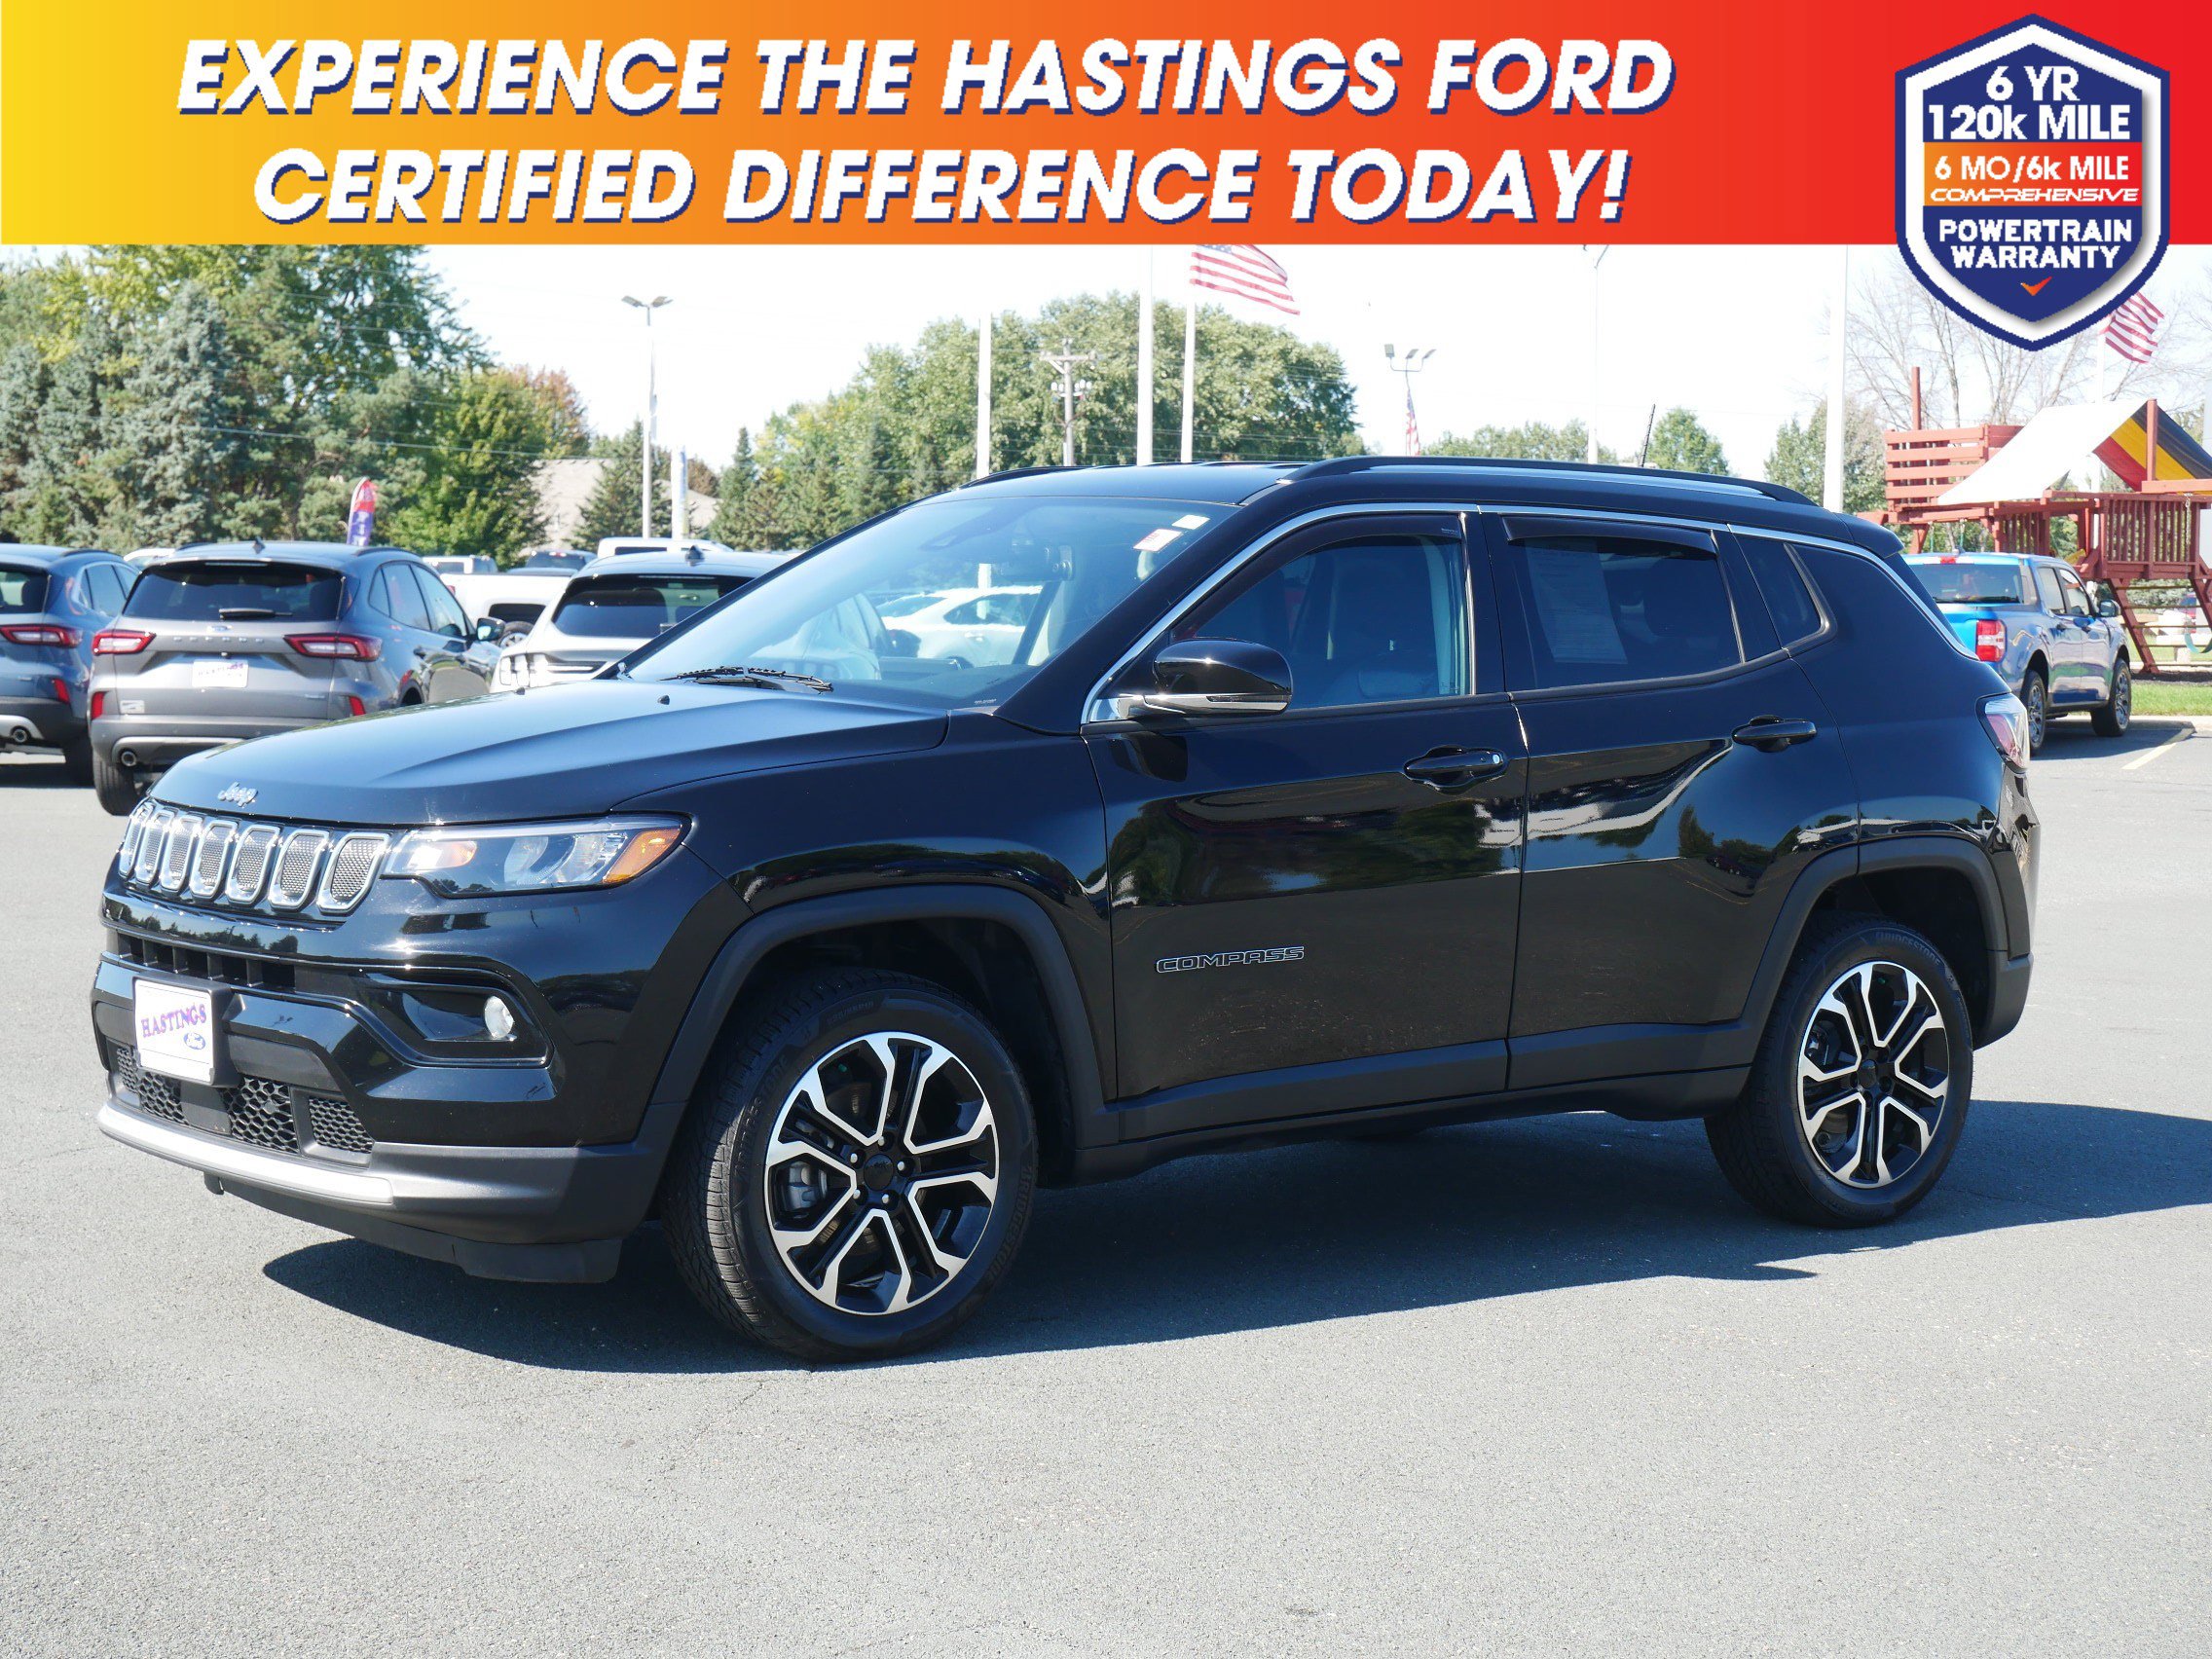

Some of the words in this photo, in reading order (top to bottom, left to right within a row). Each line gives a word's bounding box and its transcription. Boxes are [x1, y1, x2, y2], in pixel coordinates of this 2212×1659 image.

[217, 781, 258, 807] Jeep
[1156, 945, 1305, 974] COMPASS
[141, 1003, 207, 1038] HASTINGS
